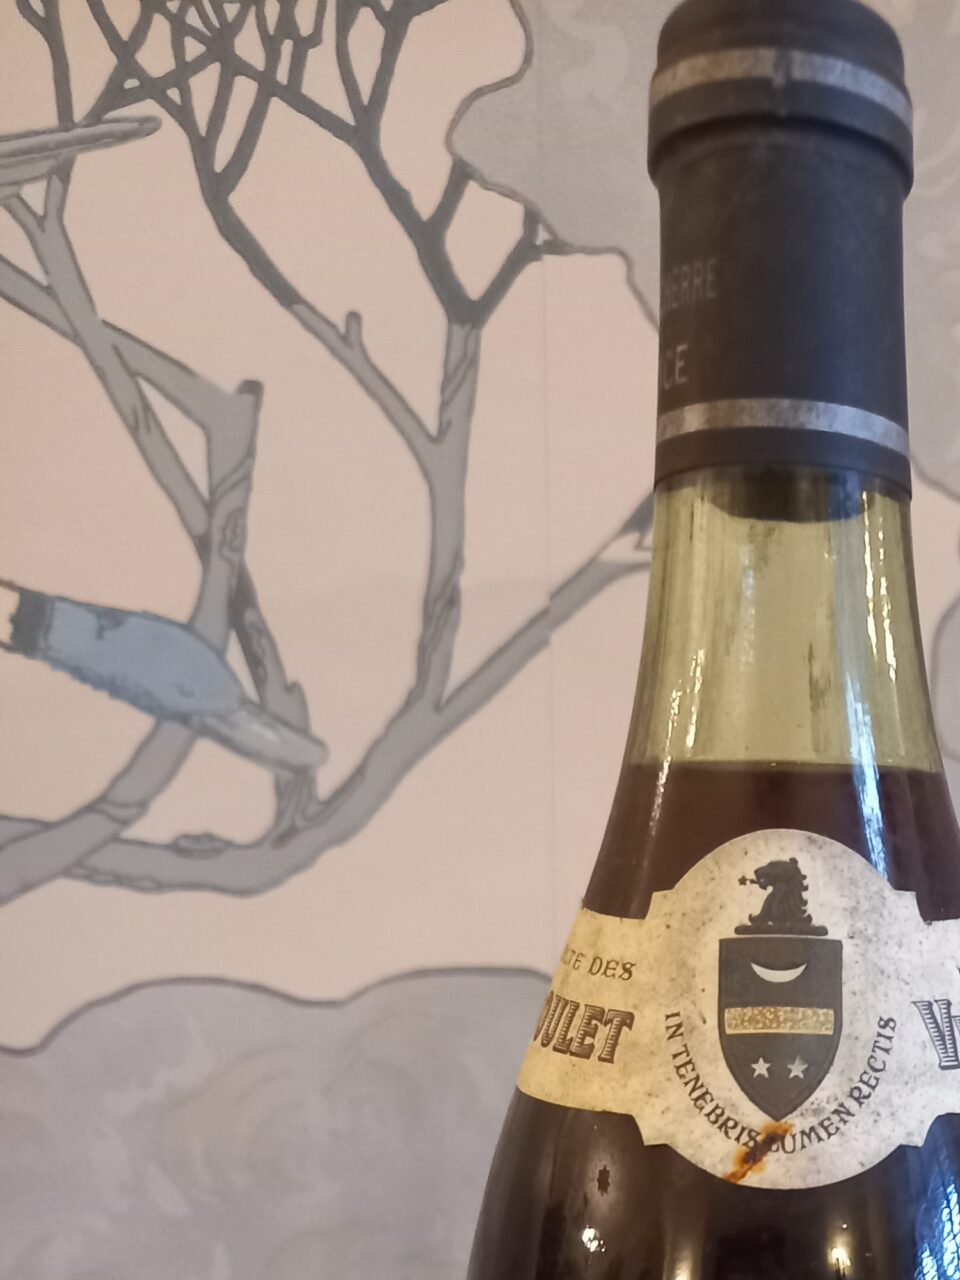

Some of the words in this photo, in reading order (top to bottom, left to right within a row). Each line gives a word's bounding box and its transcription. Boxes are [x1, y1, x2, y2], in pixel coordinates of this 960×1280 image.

[589, 956, 636, 981] DES
[664, 1011, 683, 1041] IN
[850, 1015, 897, 1108] RECTIS
[671, 1043, 761, 1150] TENEBRIS
